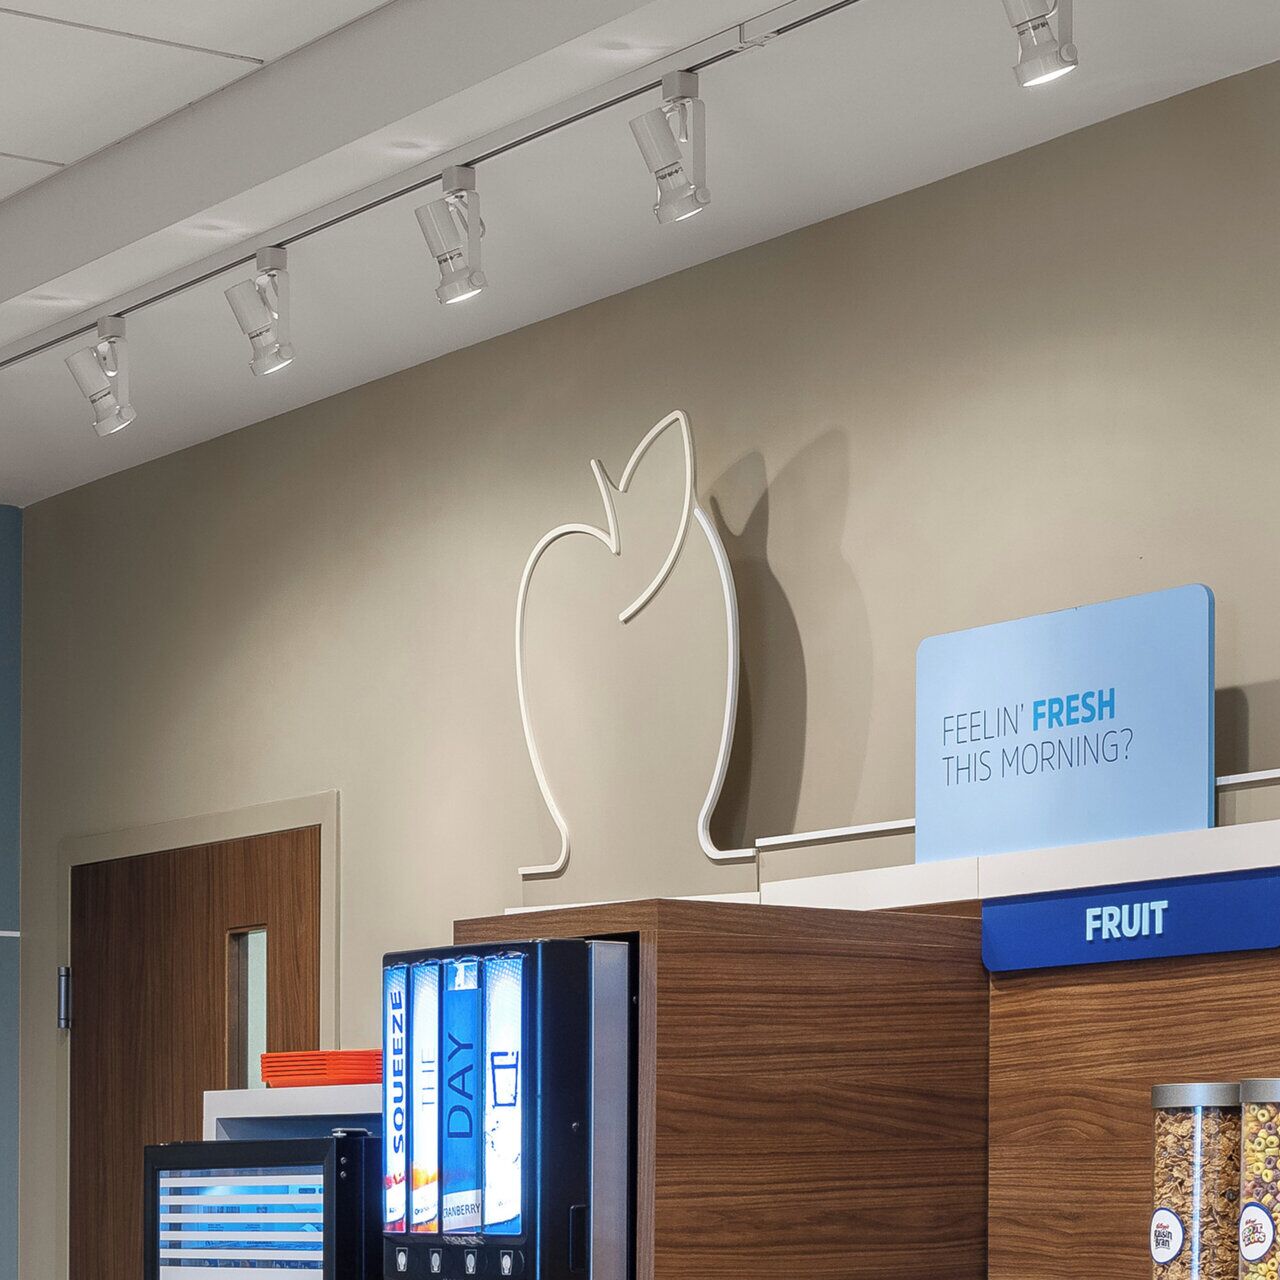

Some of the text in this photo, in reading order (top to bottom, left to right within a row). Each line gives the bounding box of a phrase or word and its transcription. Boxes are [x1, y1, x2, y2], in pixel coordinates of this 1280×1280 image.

[1032, 687, 1116, 732] FRESH
[941, 727, 1134, 786] THIS MORNING?
[1085, 900, 1169, 941] FRUIT
[389, 990, 405, 1154] SQUEEZE
[447, 1031, 474, 1139] DAY
